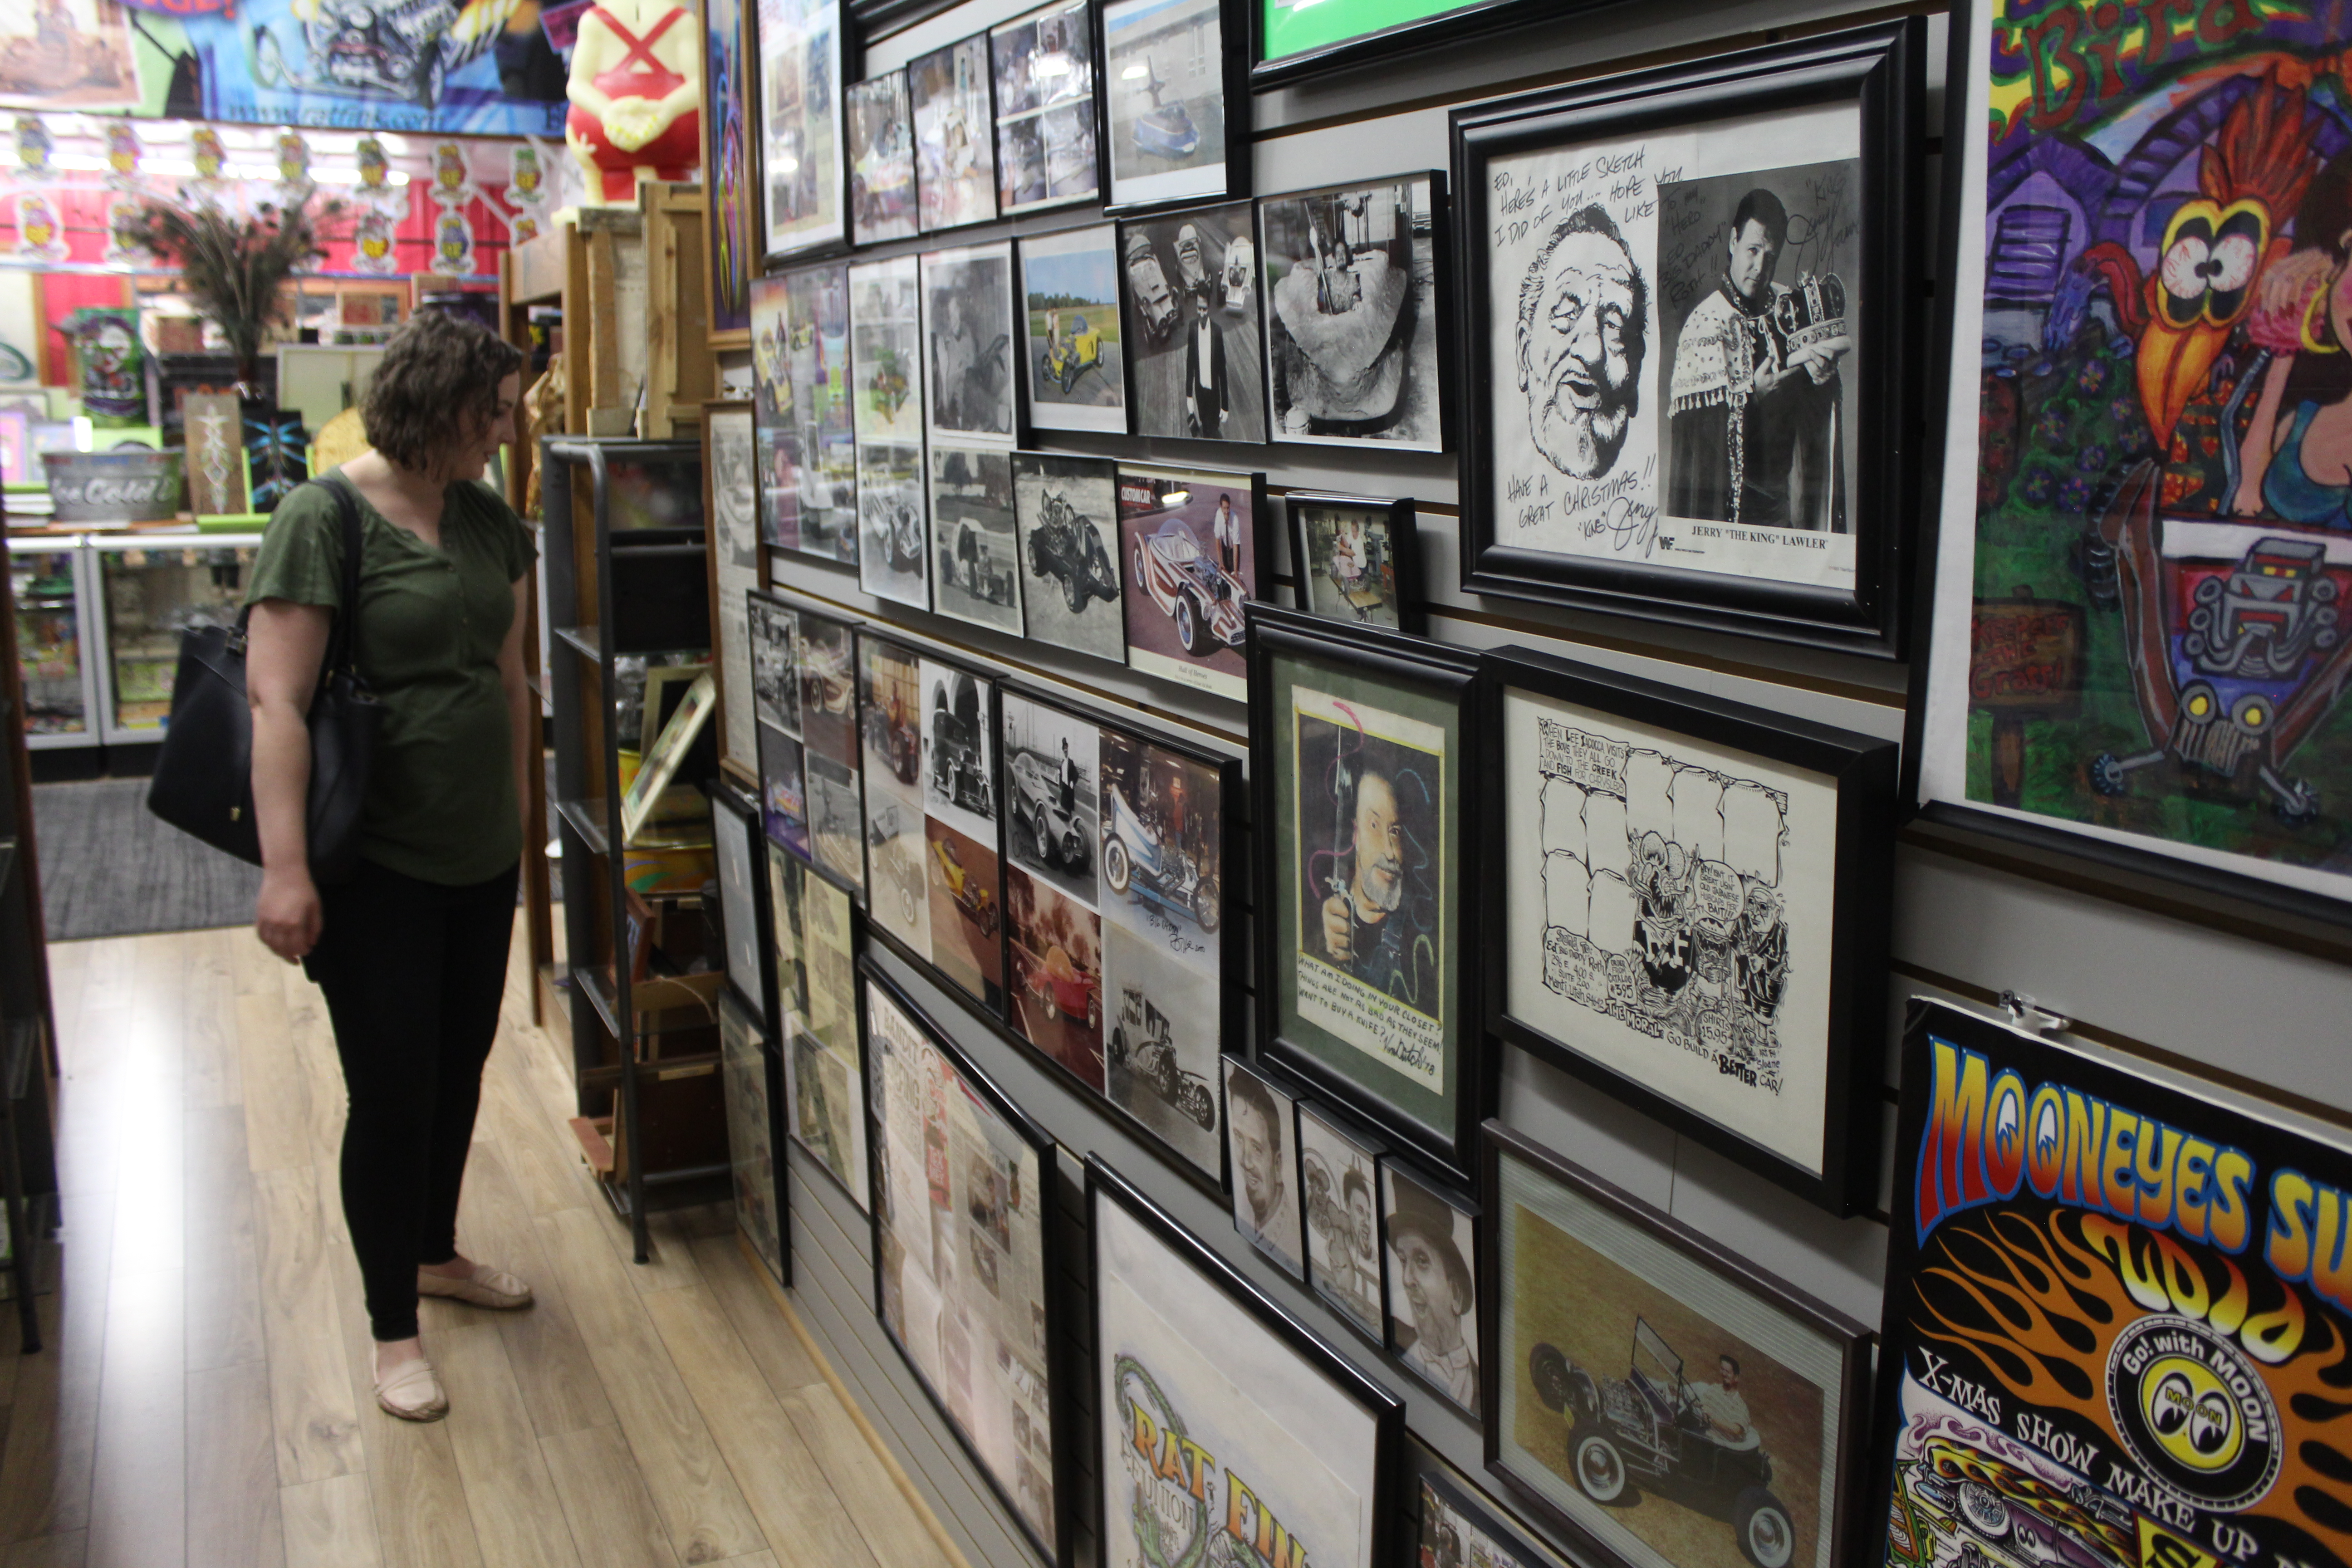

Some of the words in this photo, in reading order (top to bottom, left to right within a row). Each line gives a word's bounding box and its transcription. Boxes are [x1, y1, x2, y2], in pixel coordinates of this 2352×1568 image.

[1542, 179, 1550, 199] A
[1558, 162, 1591, 192] LITTLE
[1596, 144, 1646, 179] SKETCH
[1494, 228, 1506, 247] I
[1510, 221, 1529, 245] DID
[1534, 205, 1553, 229] OF
[1610, 175, 1646, 202] HOPE
[1654, 166, 1683, 184] YOU
[1625, 200, 1659, 223] LIKE
[1122, 486, 1140, 502] CUSTOM
[1141, 489, 1151, 504] CAR
[1508, 474, 1533, 503] HAVE
[1540, 474, 1548, 496] A
[1519, 501, 1555, 528] GREAT
[1691, 525, 1723, 538] JERRY
[1725, 529, 1747, 541] "THE
[1750, 532, 1779, 544] KING"
[1541, 724, 1562, 740] WHEN
[1566, 730, 1579, 745] LEE
[1606, 743, 1624, 759] VISITS
[1544, 737, 1555, 748] THE
[1557, 740, 1570, 754] BOYS
[1573, 745, 1588, 760] THEY
[1590, 751, 1601, 763] ALL
[1604, 755, 1615, 767] GO
[1545, 749, 1564, 763] DOWN
[1565, 755, 1573, 765] TO
[1577, 760, 1589, 771] THE
[1544, 758, 1555, 770] AND
[1557, 763, 1572, 776] FISH
[1575, 769, 1586, 781] FOR
[1589, 774, 1624, 794] CHRYSLERS
[1700, 874, 1718, 886] GREAT
[1700, 882, 1710, 892] OLD
[1712, 887, 1740, 903] JAPANESE
[1547, 940, 1559, 953] Ed
[1589, 957, 1606, 975] Roth
[1574, 965, 1587, 979] 400
[1611, 960, 1625, 968] ORDER
[1298, 956, 1319, 972] WHAT
[1335, 974, 1341, 983] I
[1342, 978, 1365, 997] DOING
[1368, 992, 1377, 1002] IN
[1379, 999, 1400, 1015] YOUR
[1558, 969, 1575, 982] SUITE
[1577, 978, 1590, 990] 200
[1608, 973, 1632, 983] CATALOG
[1298, 986, 1317, 1001] WANT
[1332, 1002, 1347, 1016] BUY
[1348, 1011, 1353, 1020] A
[1298, 971, 1319, 989] THINGS
[1322, 984, 1337, 995] ARE
[1341, 992, 1353, 1003] NOT
[1356, 1000, 1365, 1011] AS
[1368, 1008, 1384, 1020] BAD
[1387, 1016, 1396, 1029] AS
[1398, 1022, 1417, 1039] THEY
[1569, 985, 1586, 1002] Utah
[1702, 1026, 1727, 1044] 15.95
[1703, 1014, 1730, 1031] SHIRTS
[1606, 999, 1625, 1021] THE
[1667, 1031, 1681, 1046] GO
[1684, 1039, 1709, 1059] BUILD
[1711, 1053, 1719, 1065] A
[1719, 1054, 1757, 1088] BETTER
[1760, 1075, 1783, 1096] CAR!
[1914, 1033, 2256, 1256] MOONEYES
[2122, 1336, 2154, 1375] Go!
[2153, 1329, 2205, 1360] with
[2209, 1350, 2269, 1442] MOON
[2166, 1387, 2222, 1426] MOON
[1919, 1346, 2000, 1426] X-MAS
[2016, 1412, 2099, 1476] SHOW
[2102, 1462, 2195, 1534] MAKE
[2212, 1517, 2259, 1562] UP
[1120, 1430, 1196, 1537] REUNION
[1132, 1397, 1215, 1503] RAT
[1224, 1467, 1308, 1568] FIN
